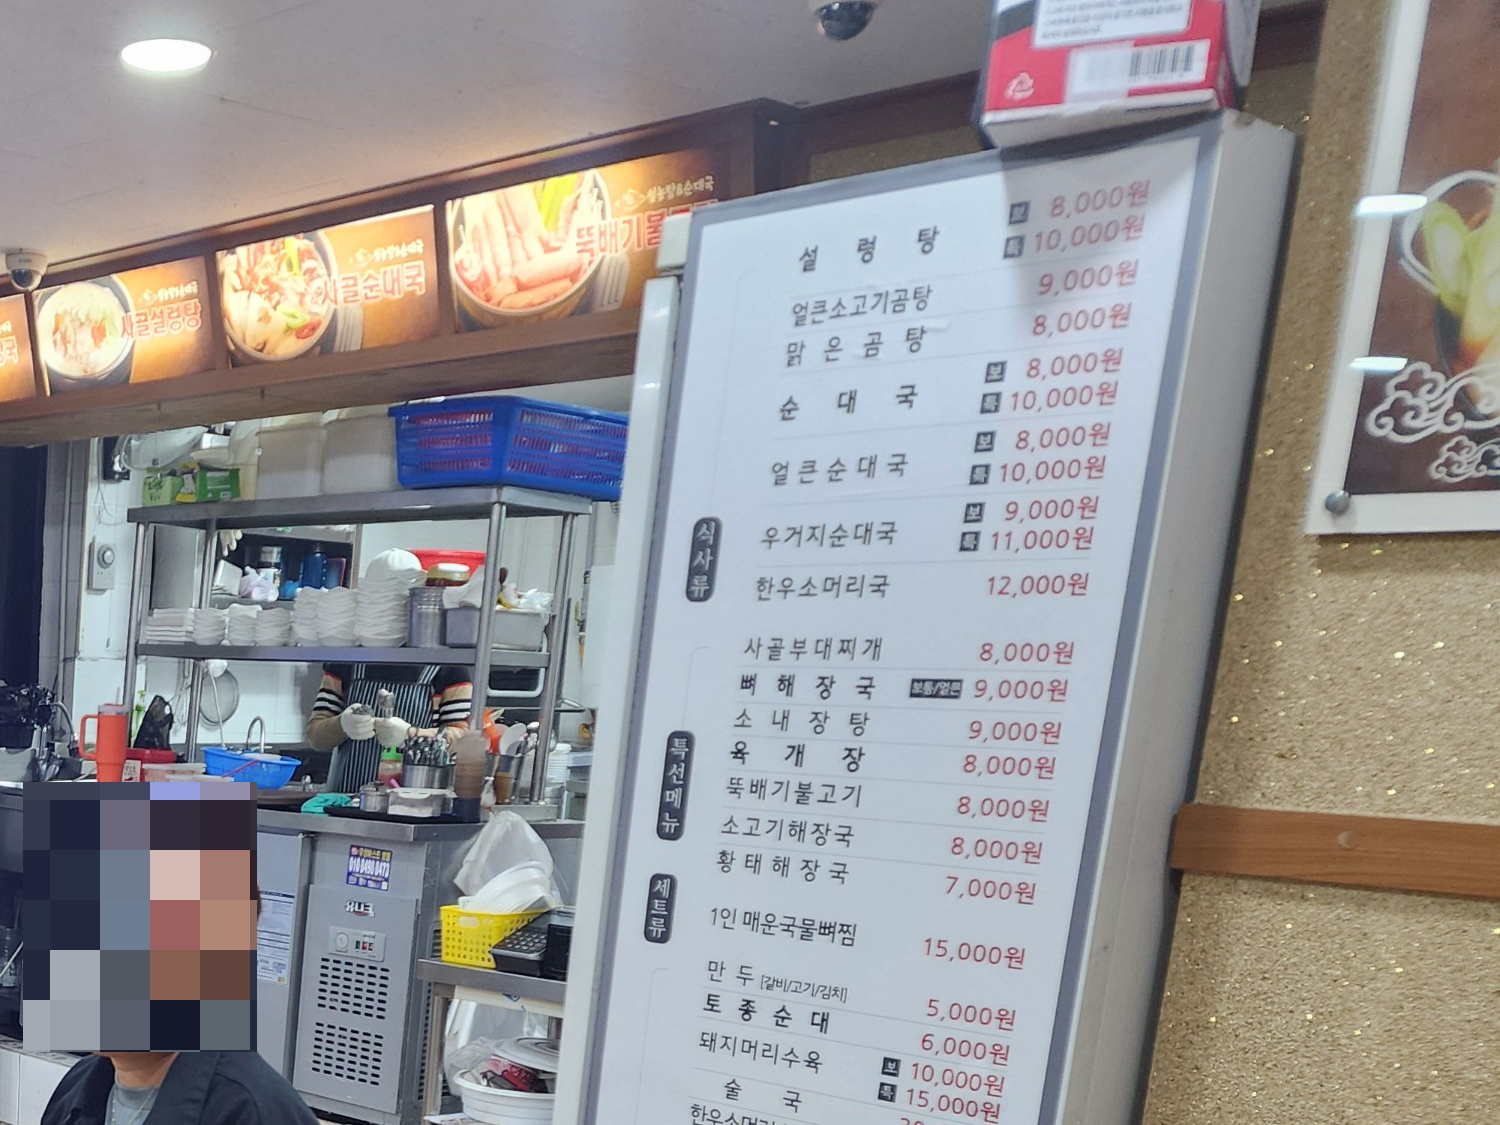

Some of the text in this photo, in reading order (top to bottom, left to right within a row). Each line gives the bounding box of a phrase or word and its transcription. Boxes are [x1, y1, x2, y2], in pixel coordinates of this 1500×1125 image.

[1050, 181, 1151, 217] 8,000원
[1035, 214, 1145, 252] 10,000원
[320, 260, 425, 306] 사골순대국
[793, 259, 1138, 327] 얼큰소고기곰탕 9,000원
[120, 299, 202, 338] 사골설렁탕
[1033, 302, 1132, 338] 8,000원
[1026, 348, 1124, 381] 8,000원
[1011, 381, 1118, 413] 10,000원
[1015, 423, 1111, 451] 8,000원
[771, 453, 909, 487] 얼큰순대국
[1001, 455, 1107, 486] 10,000원
[1005, 495, 1100, 523] 9,000원
[761, 521, 898, 550] 우거지순대국
[991, 526, 1094, 553] 11,000원
[688, 521, 719, 597] 식사류
[756, 572, 1090, 601] 한우소머리국 12,000원
[744, 637, 1075, 666] 사골부대찌개 8,000원
[974, 679, 1068, 702] 9,000원
[968, 720, 1062, 745] 9,000원
[661, 736, 690, 833] 특선메뉴
[963, 754, 1057, 780] 8,000원
[726, 776, 1050, 823] 뚝배기불고기 8,000원
[720, 815, 1043, 865] 소고기해장국 8,000원
[716, 849, 1037, 906] 황태해장국 7,000원
[648, 877, 673, 939] 세트류
[710, 907, 1026, 971] 1인 매운국물뼈찜 15,000원
[925, 998, 1016, 1033] 5,000원
[699, 1030, 824, 1075] 돼지머리수육
[921, 1033, 1010, 1067] 6,000원
[910, 1062, 1005, 1099] 10,000원
[906, 1088, 1000, 1125] 15,000원
